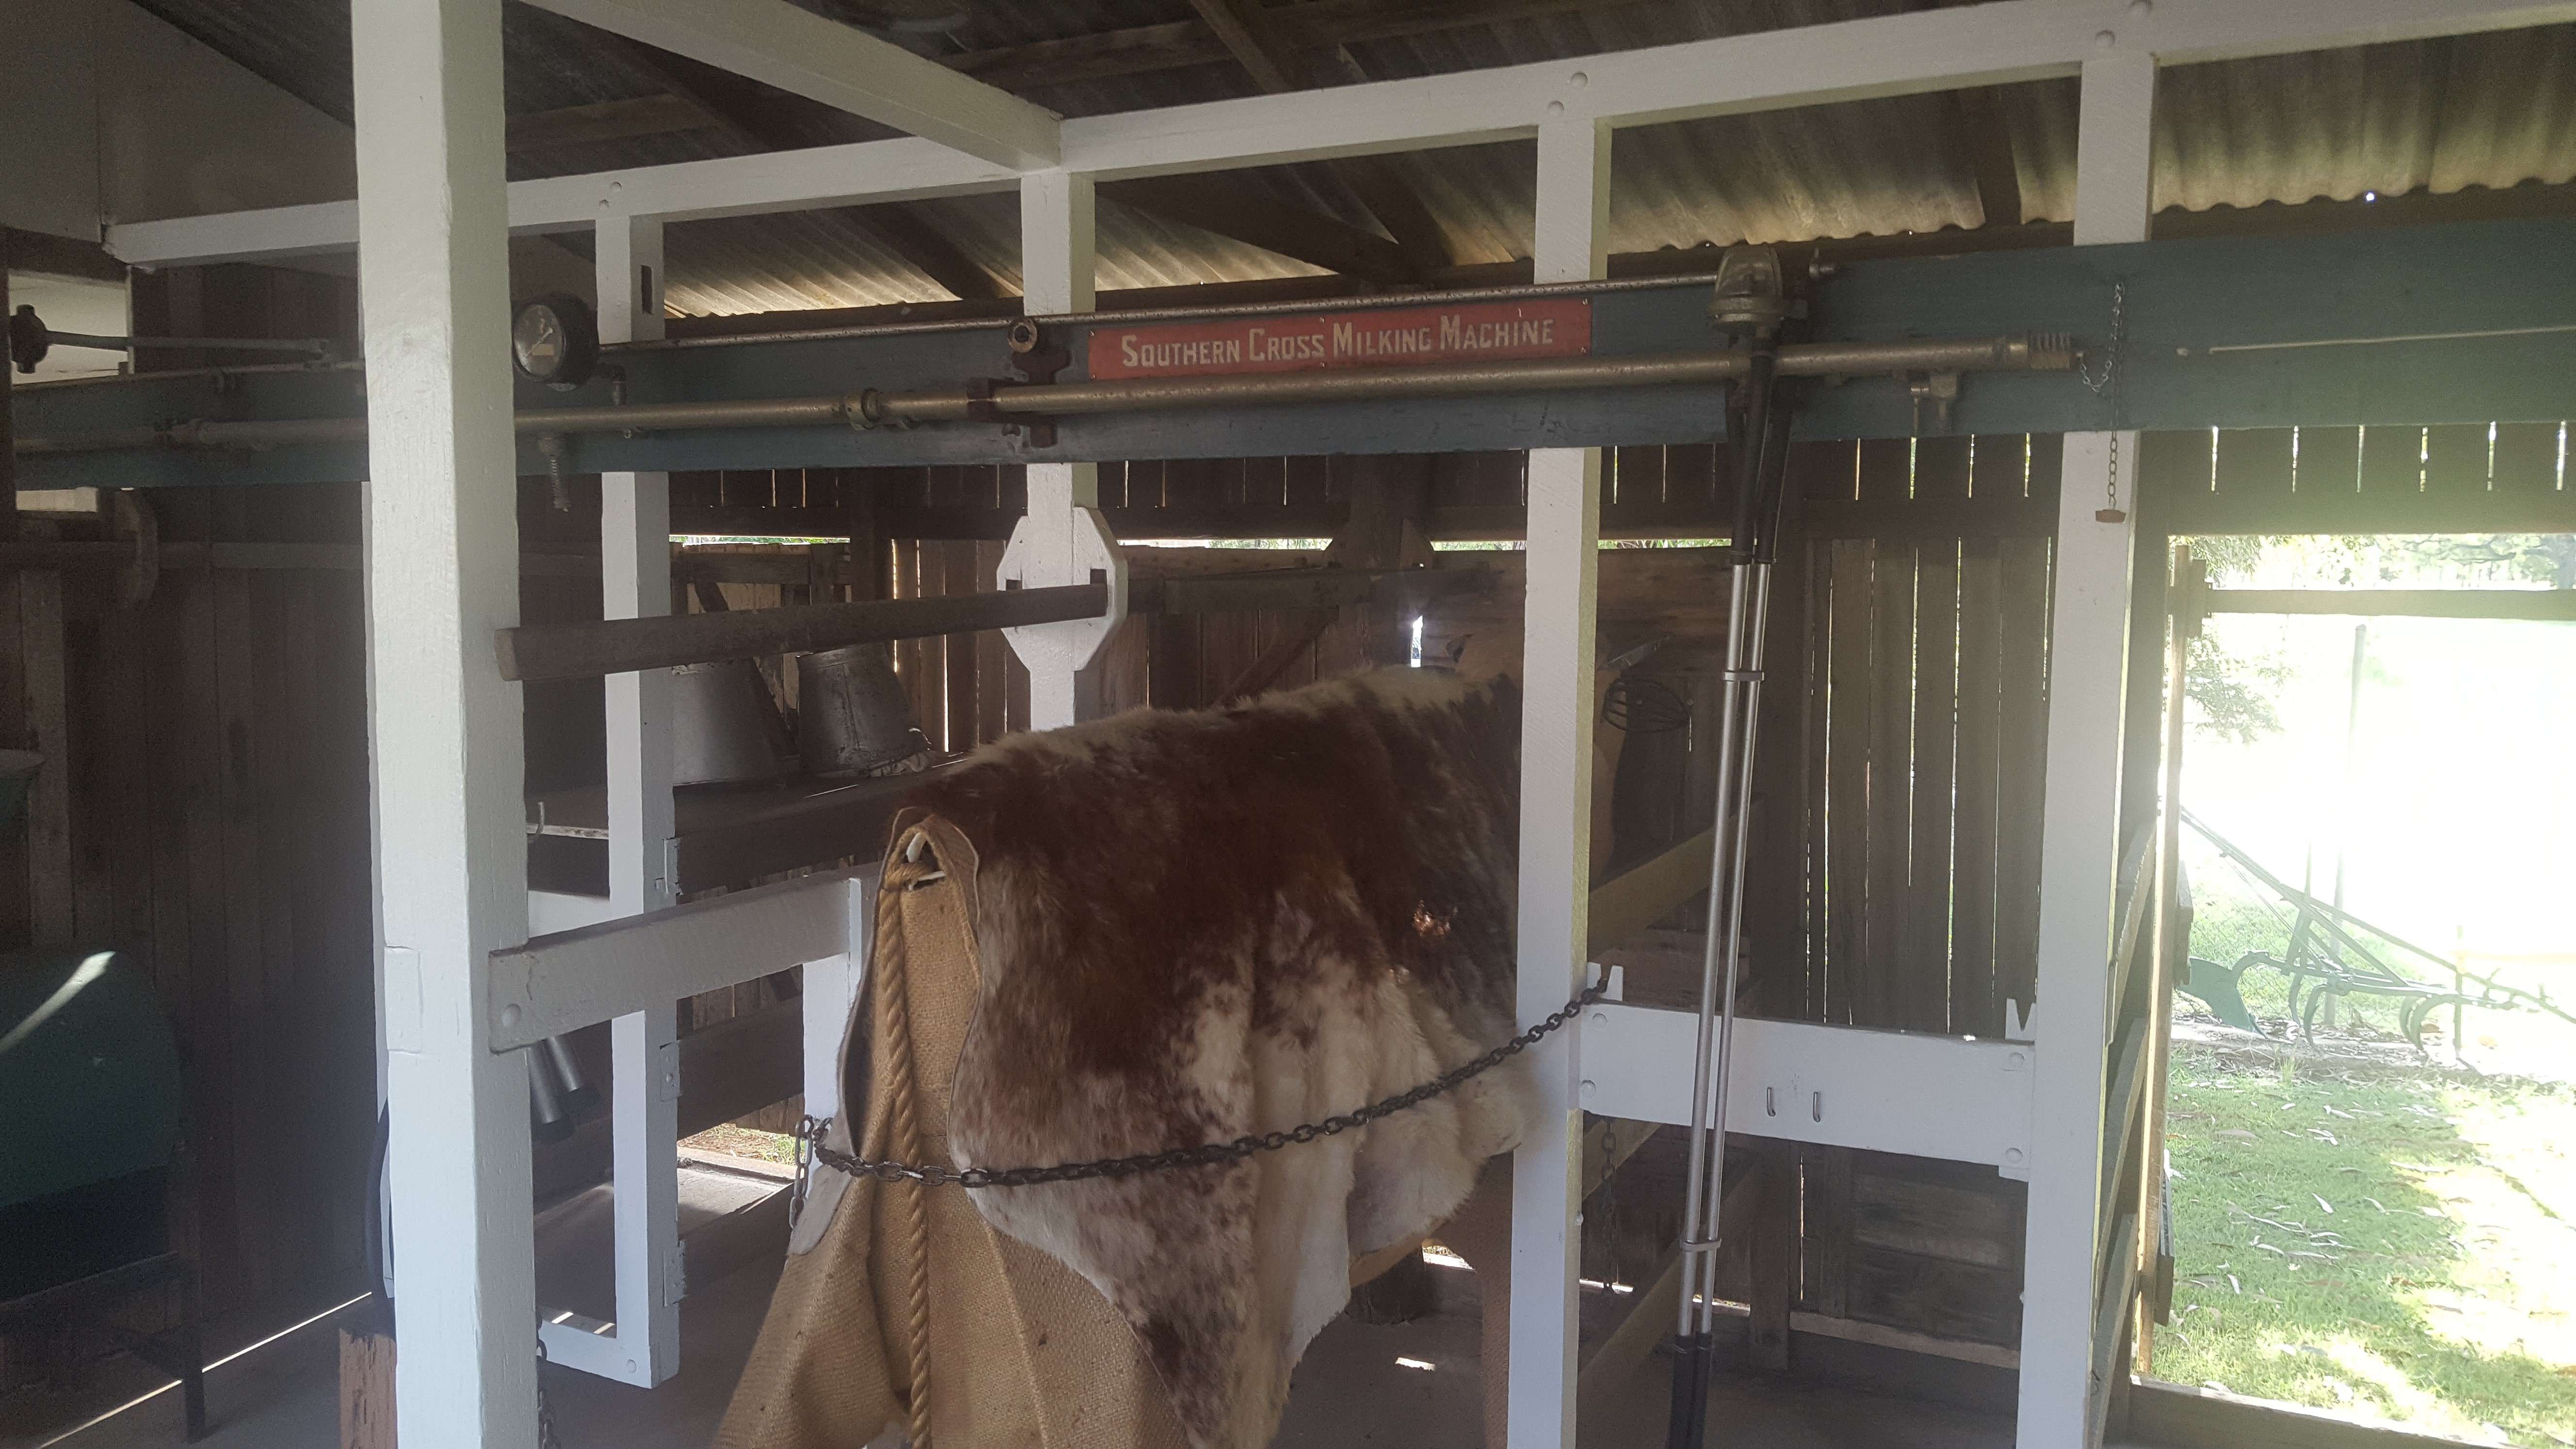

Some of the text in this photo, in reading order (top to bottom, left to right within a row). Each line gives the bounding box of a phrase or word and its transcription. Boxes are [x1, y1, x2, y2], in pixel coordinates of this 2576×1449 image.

[1122, 314, 1553, 367] SOUTHERN CROSS MILKING MACHINE
